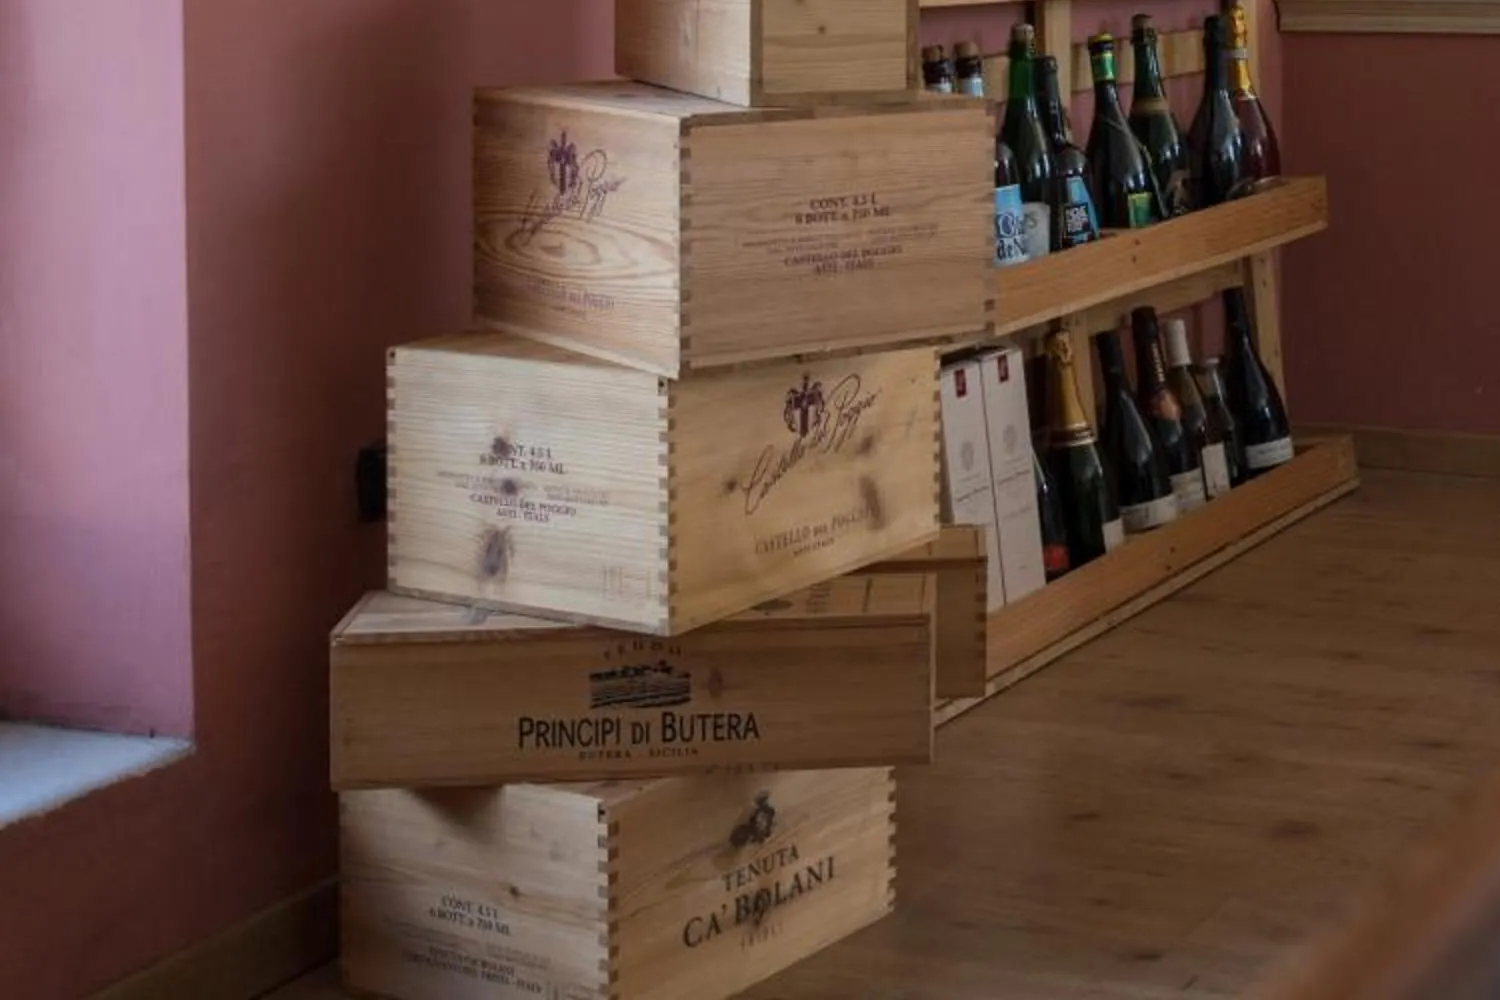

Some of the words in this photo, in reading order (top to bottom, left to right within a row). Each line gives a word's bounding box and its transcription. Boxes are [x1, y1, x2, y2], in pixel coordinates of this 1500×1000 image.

[518, 716, 621, 749] PRINCIPI
[661, 711, 762, 743] BUTERA
[721, 844, 800, 892] TENUTA
[734, 856, 835, 926] BOLANI
